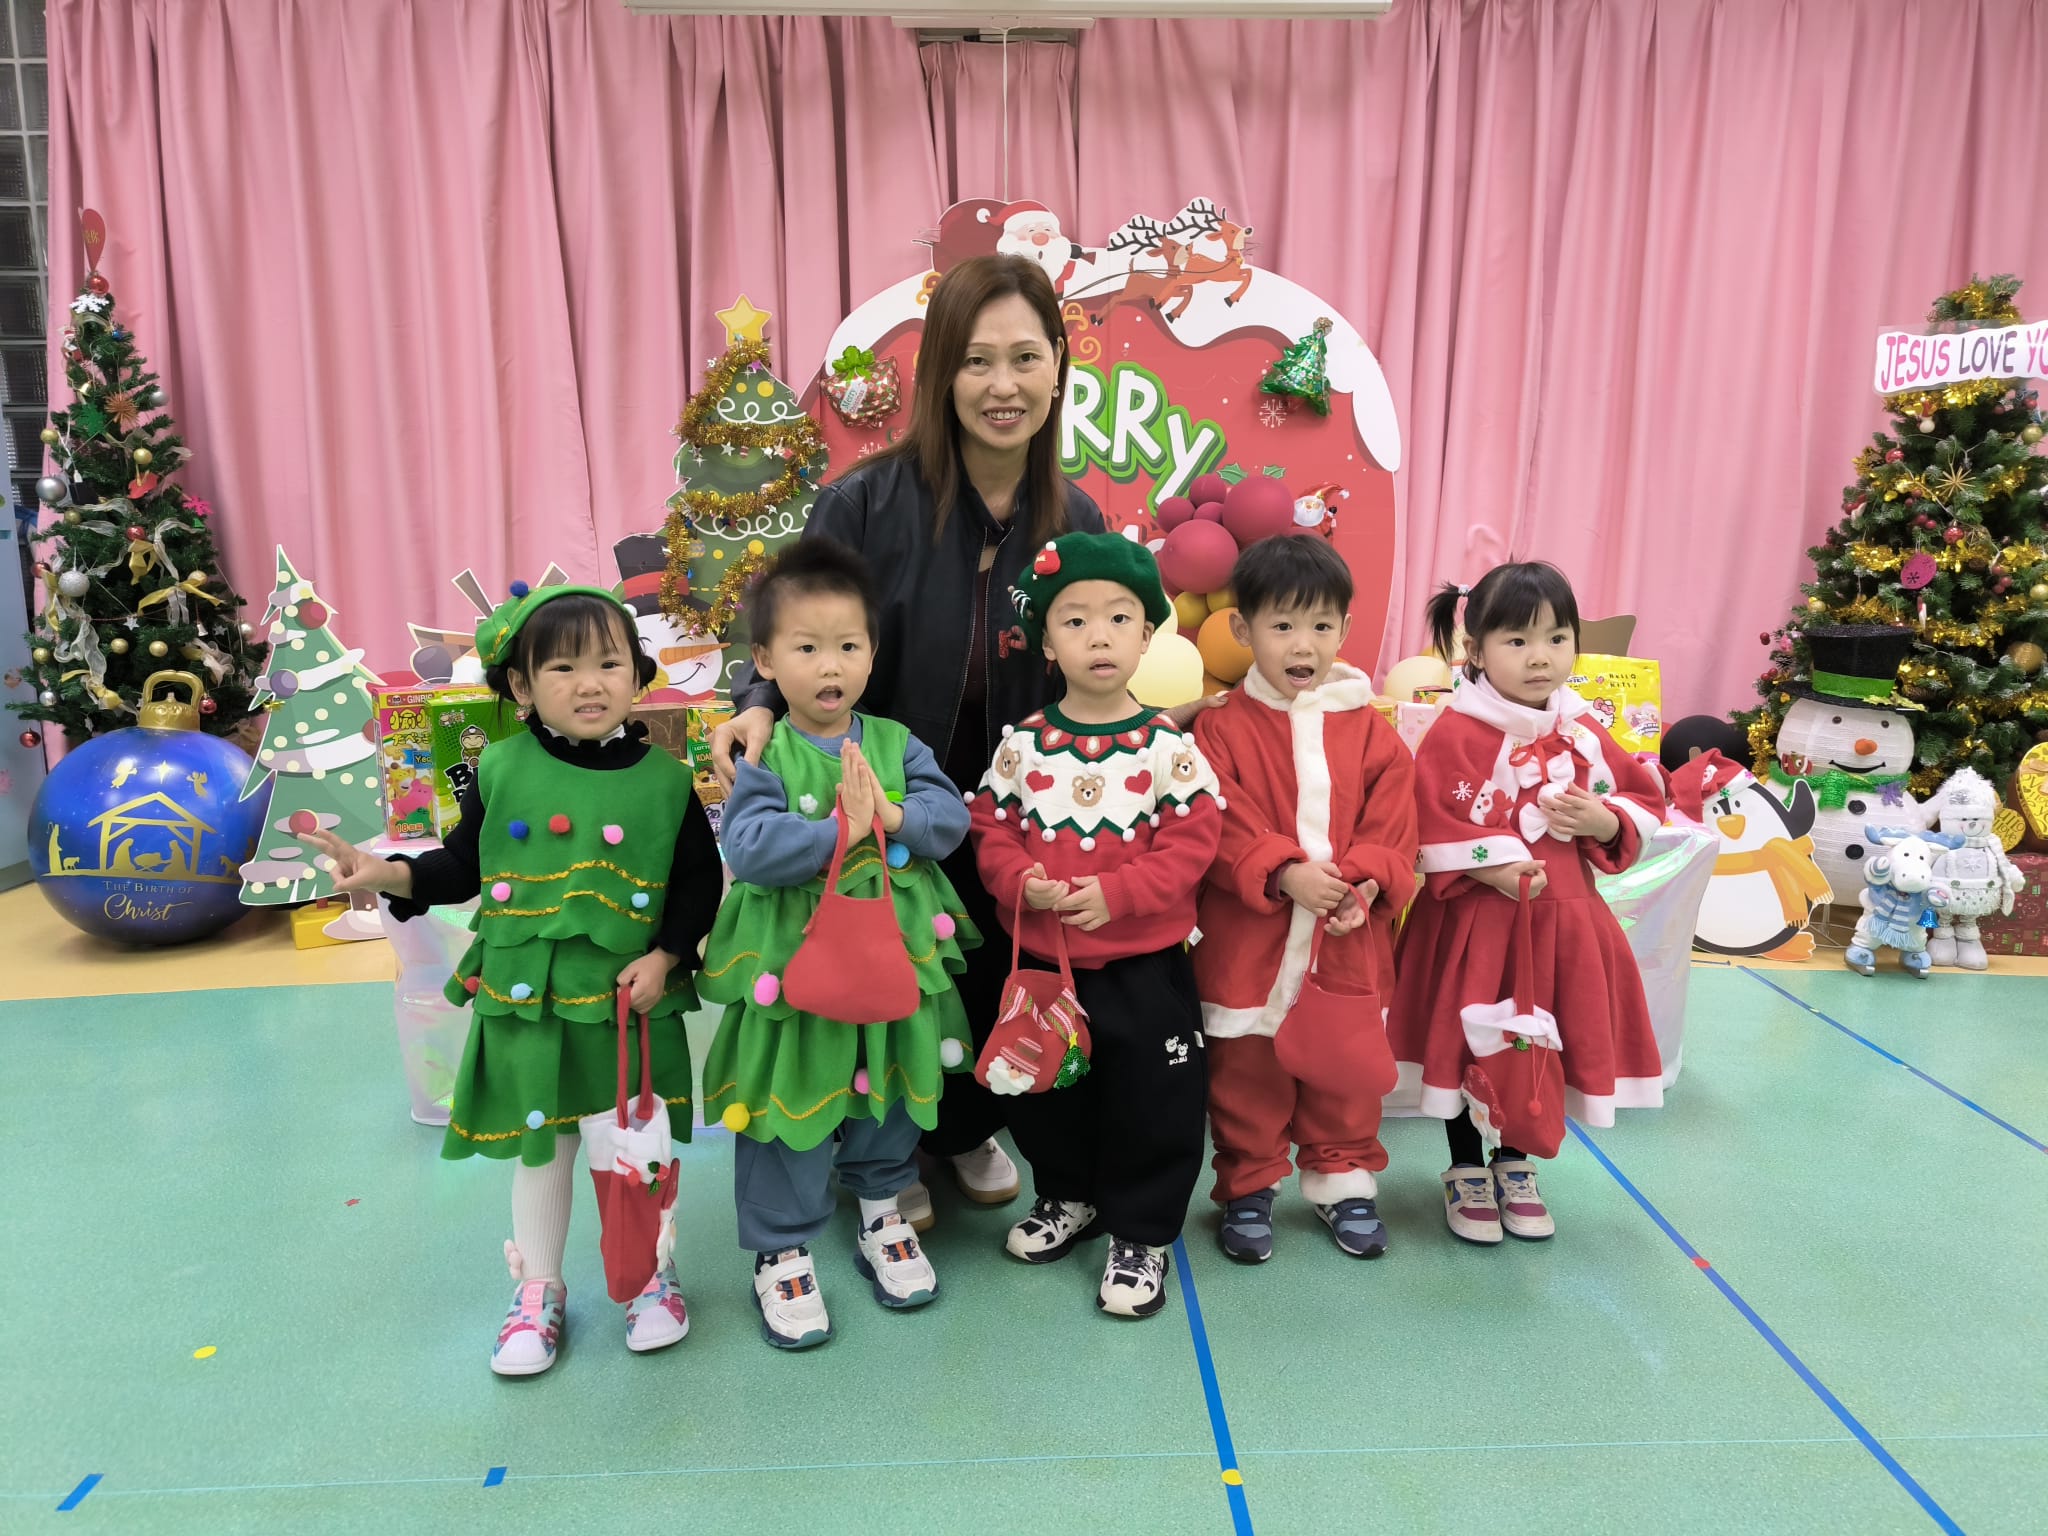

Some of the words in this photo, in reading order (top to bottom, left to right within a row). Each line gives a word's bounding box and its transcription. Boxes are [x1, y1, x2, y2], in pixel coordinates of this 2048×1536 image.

[1881, 335, 1950, 390] JESUS
[1959, 331, 2018, 374] LOVE
[2027, 328, 2048, 374] YO
[104, 893, 193, 920] Christ
